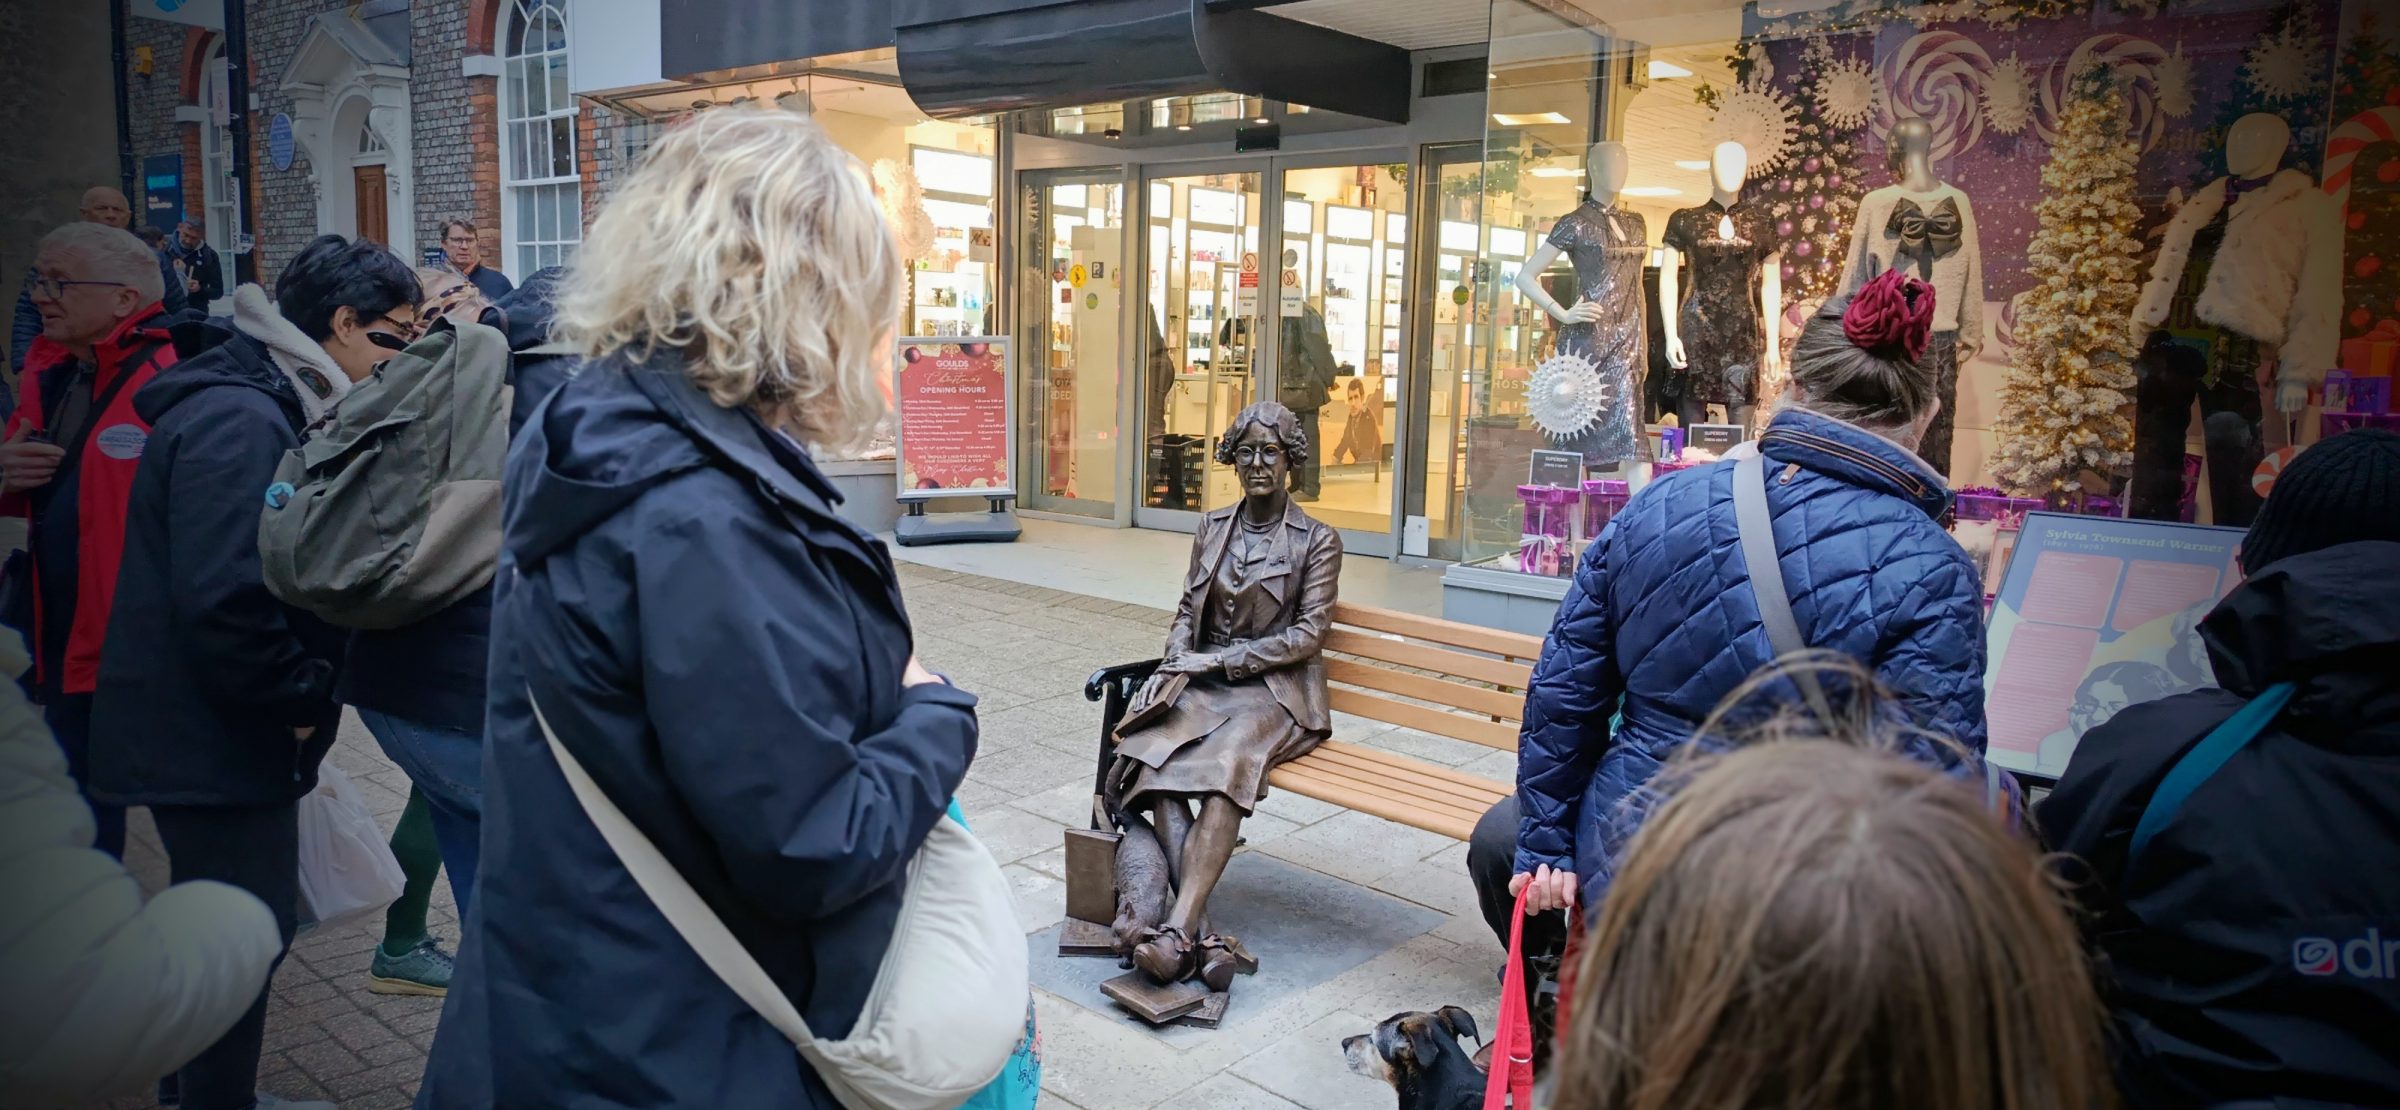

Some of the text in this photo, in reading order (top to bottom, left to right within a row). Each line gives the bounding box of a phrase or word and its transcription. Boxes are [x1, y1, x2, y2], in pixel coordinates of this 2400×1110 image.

[935, 359, 969, 368] GOULDS
[924, 370, 981, 385] Christmas
[920, 386, 957, 394] OPENING
[2045, 528, 2225, 553] Sylvia Townsend Warner
